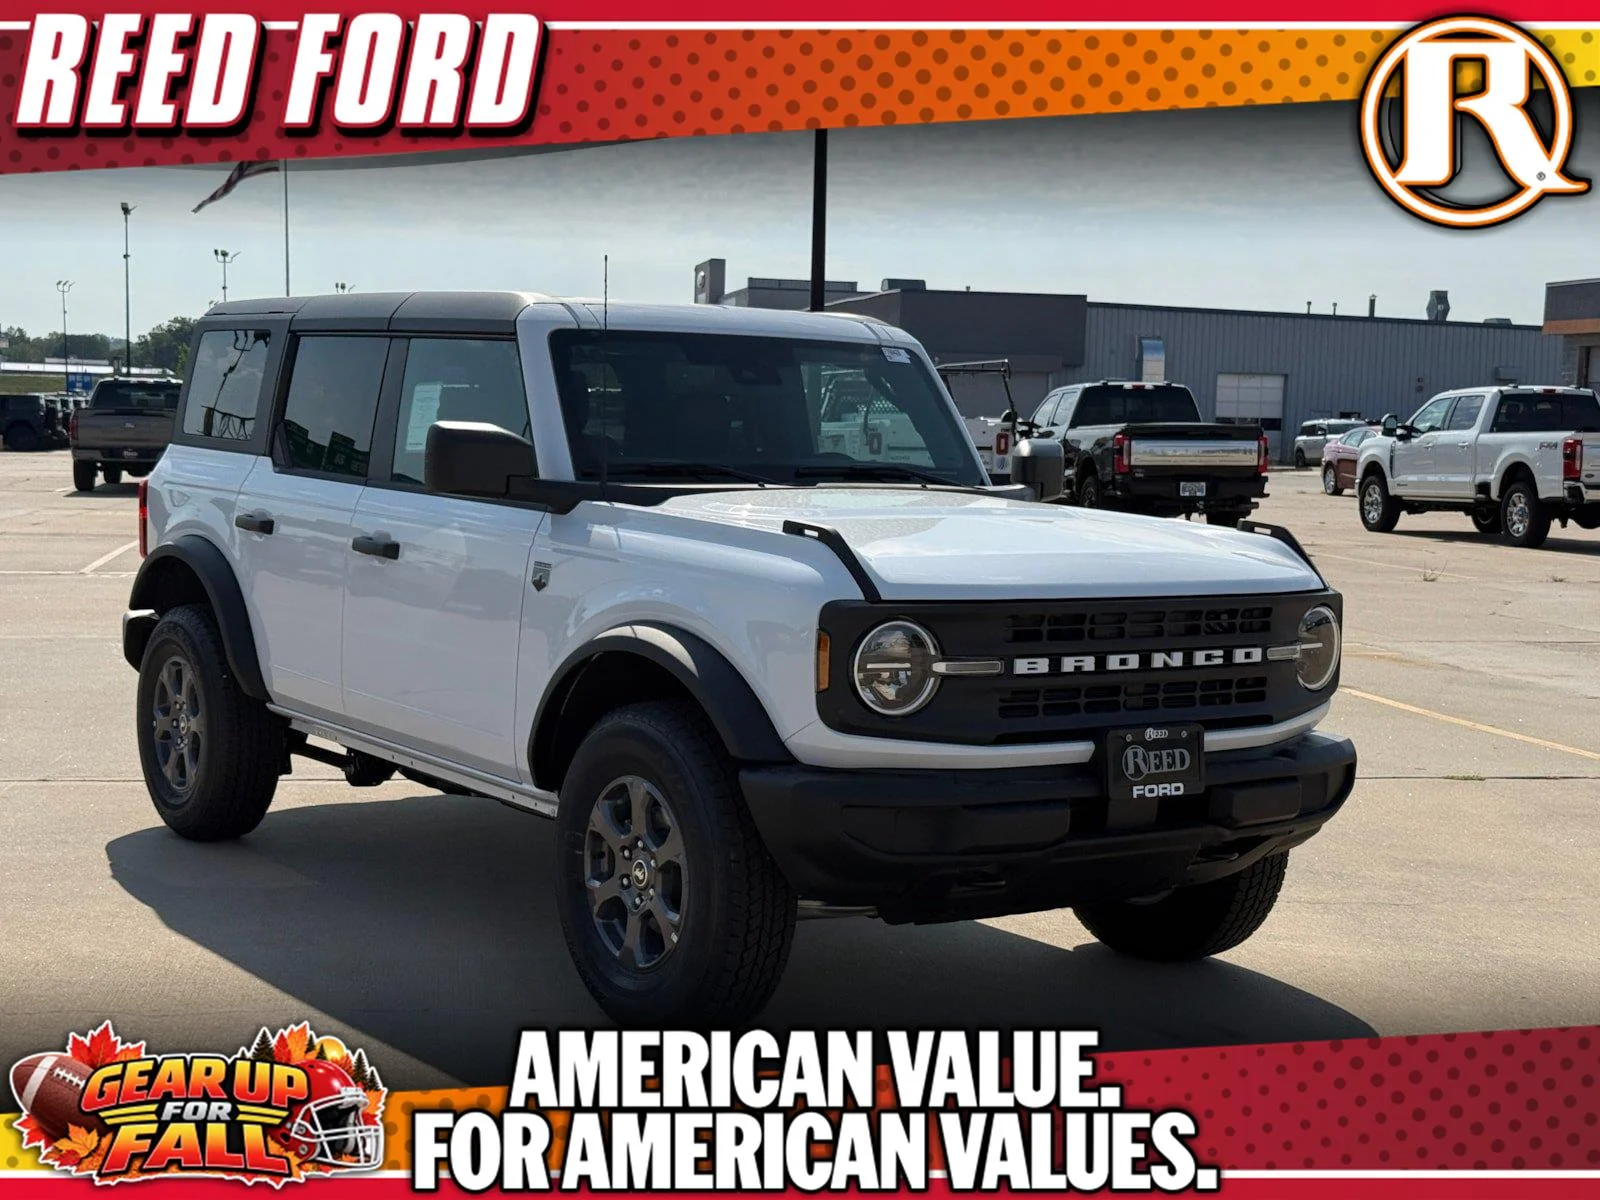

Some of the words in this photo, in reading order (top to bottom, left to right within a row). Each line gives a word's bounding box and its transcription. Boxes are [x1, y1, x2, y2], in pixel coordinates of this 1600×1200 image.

[1013, 647, 1263, 675] BRONCO
[1144, 727, 1169, 741] REED
[1122, 745, 1191, 780] REED
[1132, 782, 1185, 799] FORD
